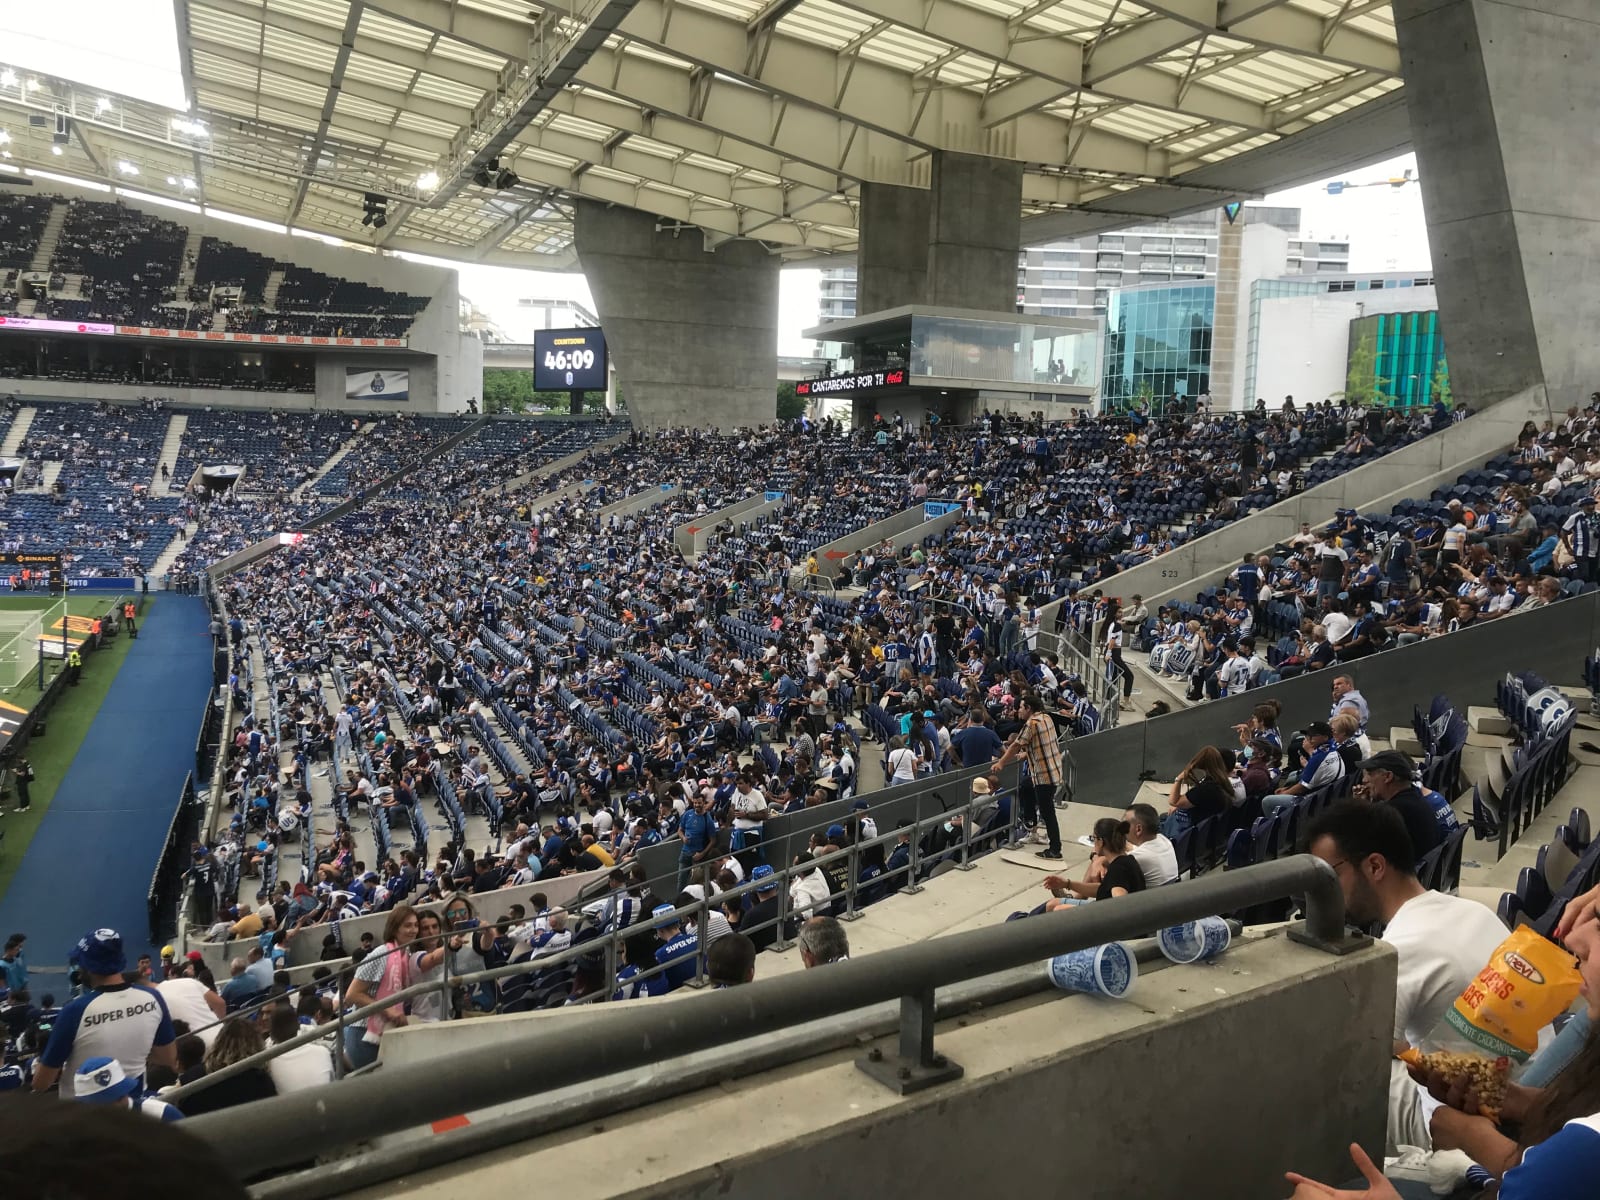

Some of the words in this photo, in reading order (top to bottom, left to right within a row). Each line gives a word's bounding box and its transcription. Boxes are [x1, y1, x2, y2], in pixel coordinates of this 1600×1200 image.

[544, 349, 594, 370] 46:09
[812, 376, 855, 393] CANTAREMOS
[857, 375, 873, 388] POR
[1168, 570, 1178, 578] 23
[83, 1009, 124, 1028] SUPER
[126, 1000, 157, 1018] BOCK
